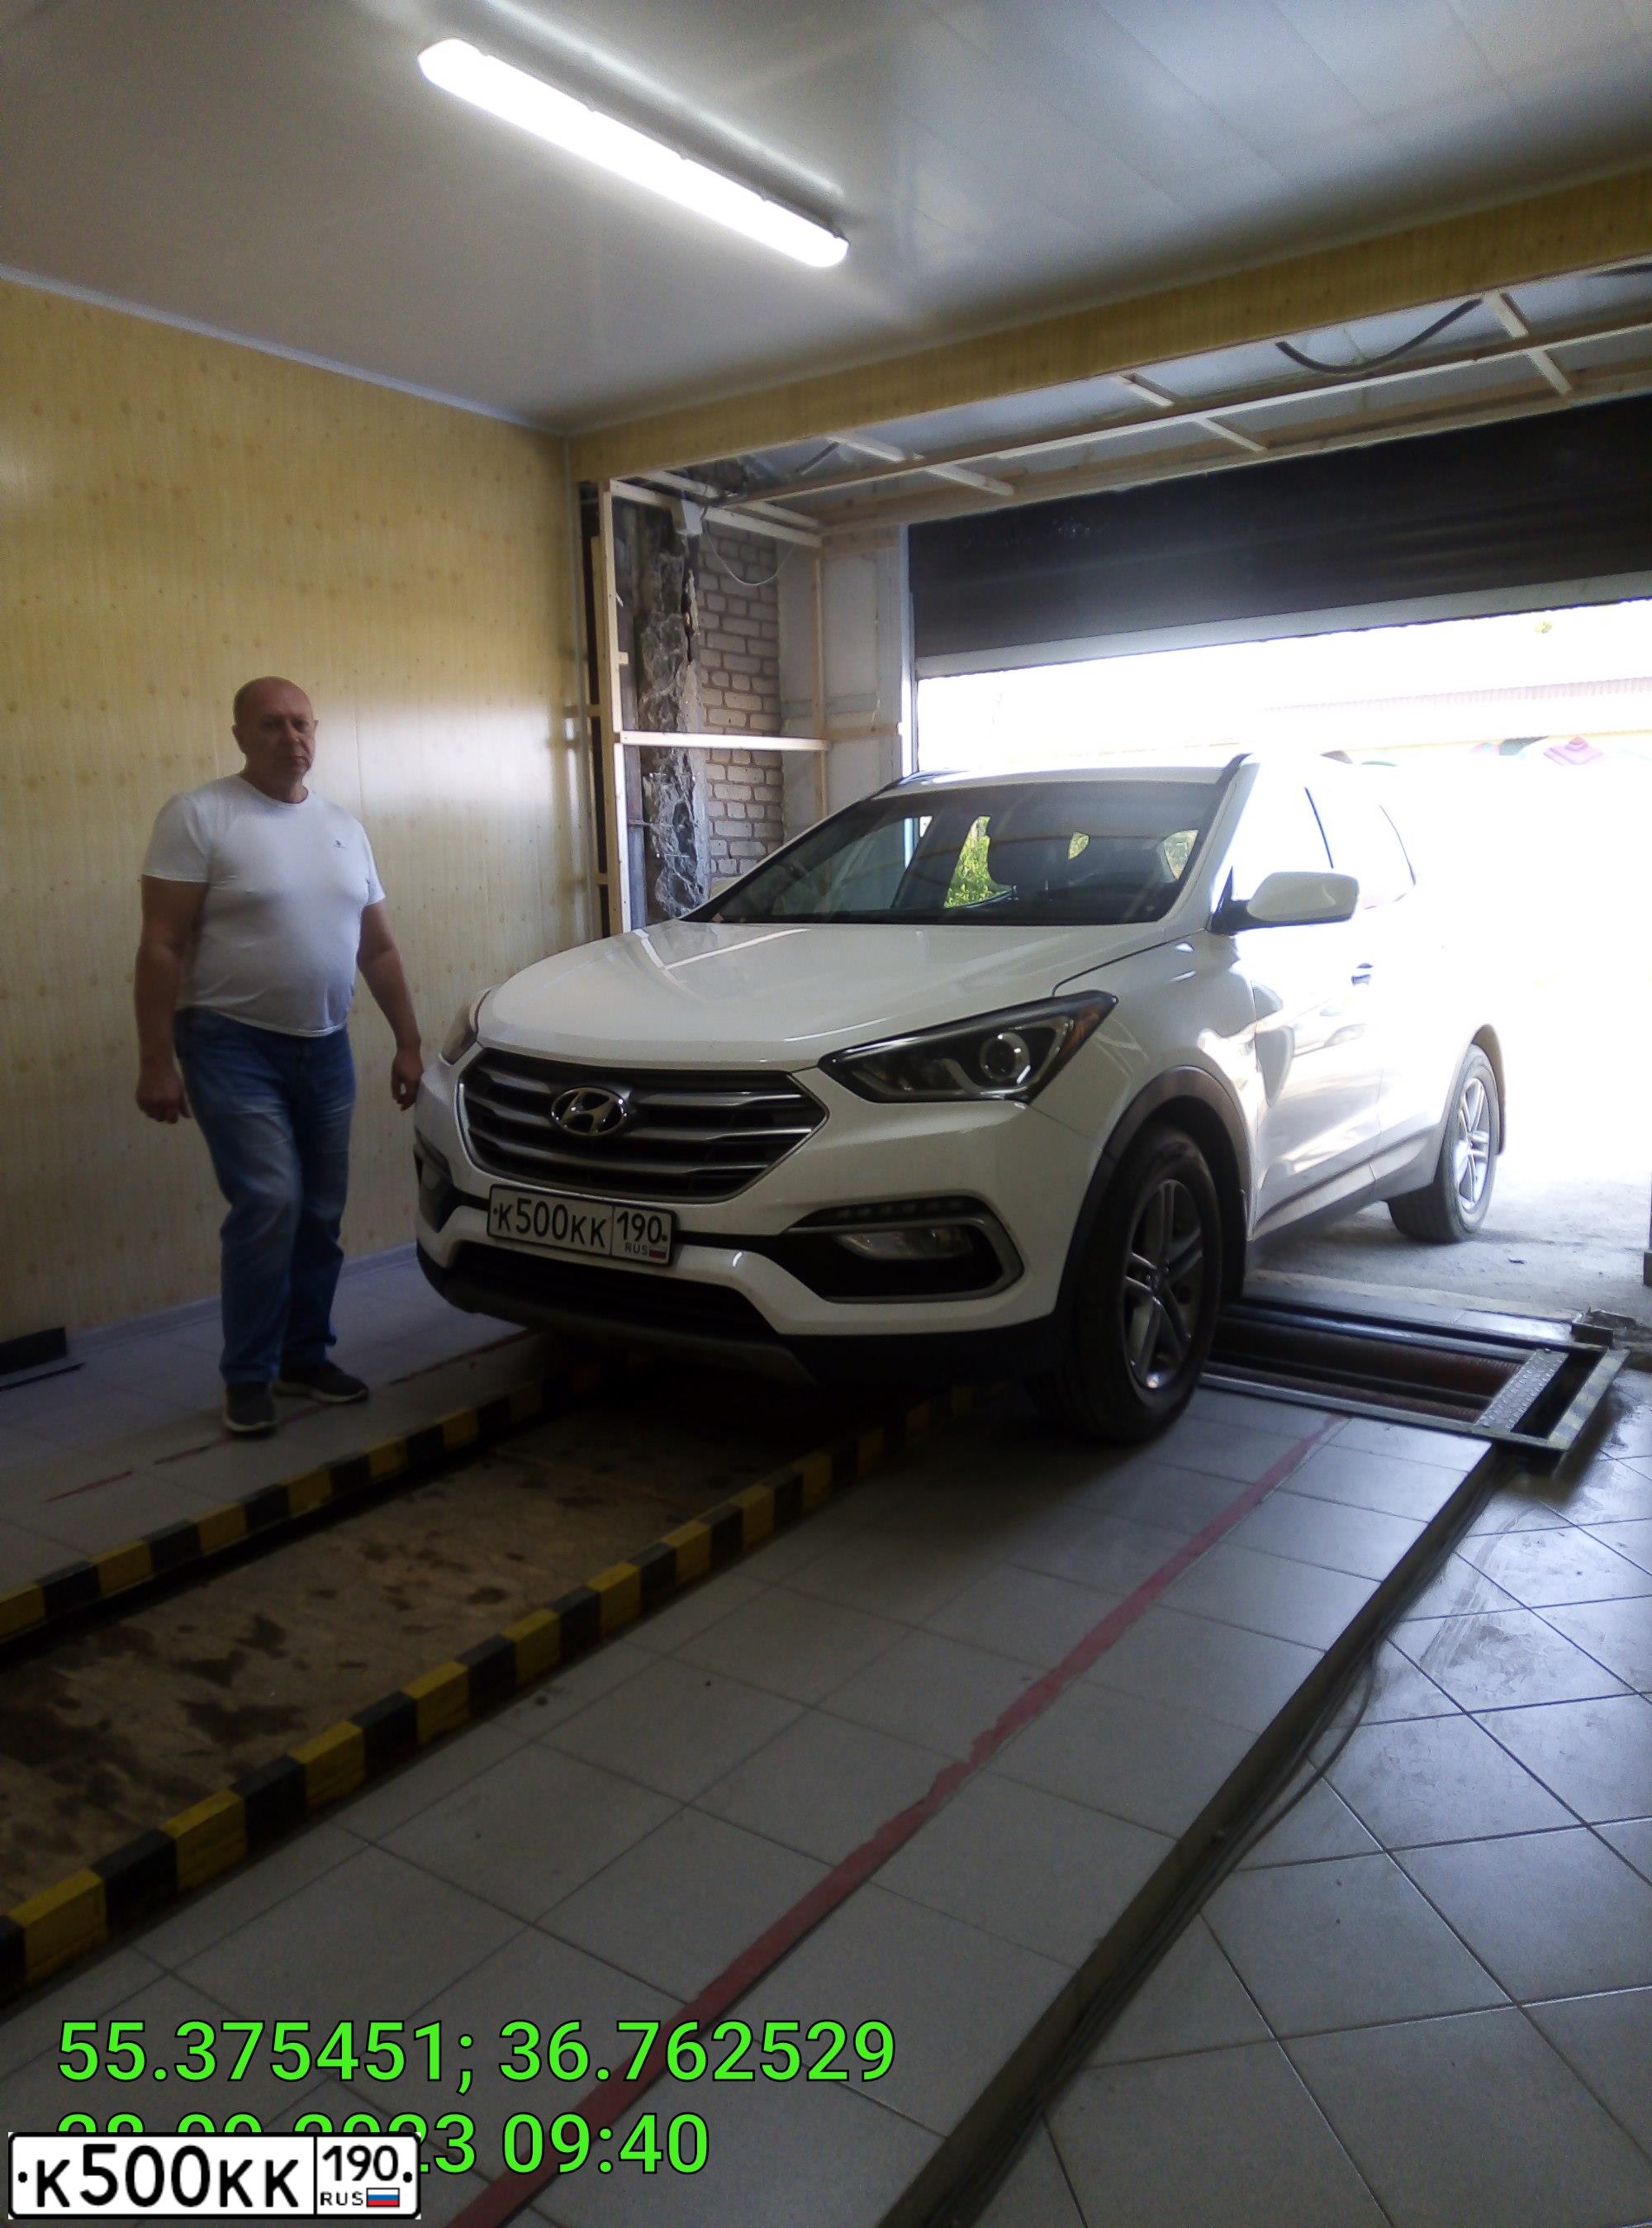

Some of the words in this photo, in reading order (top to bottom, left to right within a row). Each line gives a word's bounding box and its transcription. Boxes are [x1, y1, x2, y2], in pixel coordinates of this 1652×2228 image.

[497, 1198, 608, 1248] K500KK
[616, 1210, 663, 1244] 190
[624, 1242, 648, 1257] RUS
